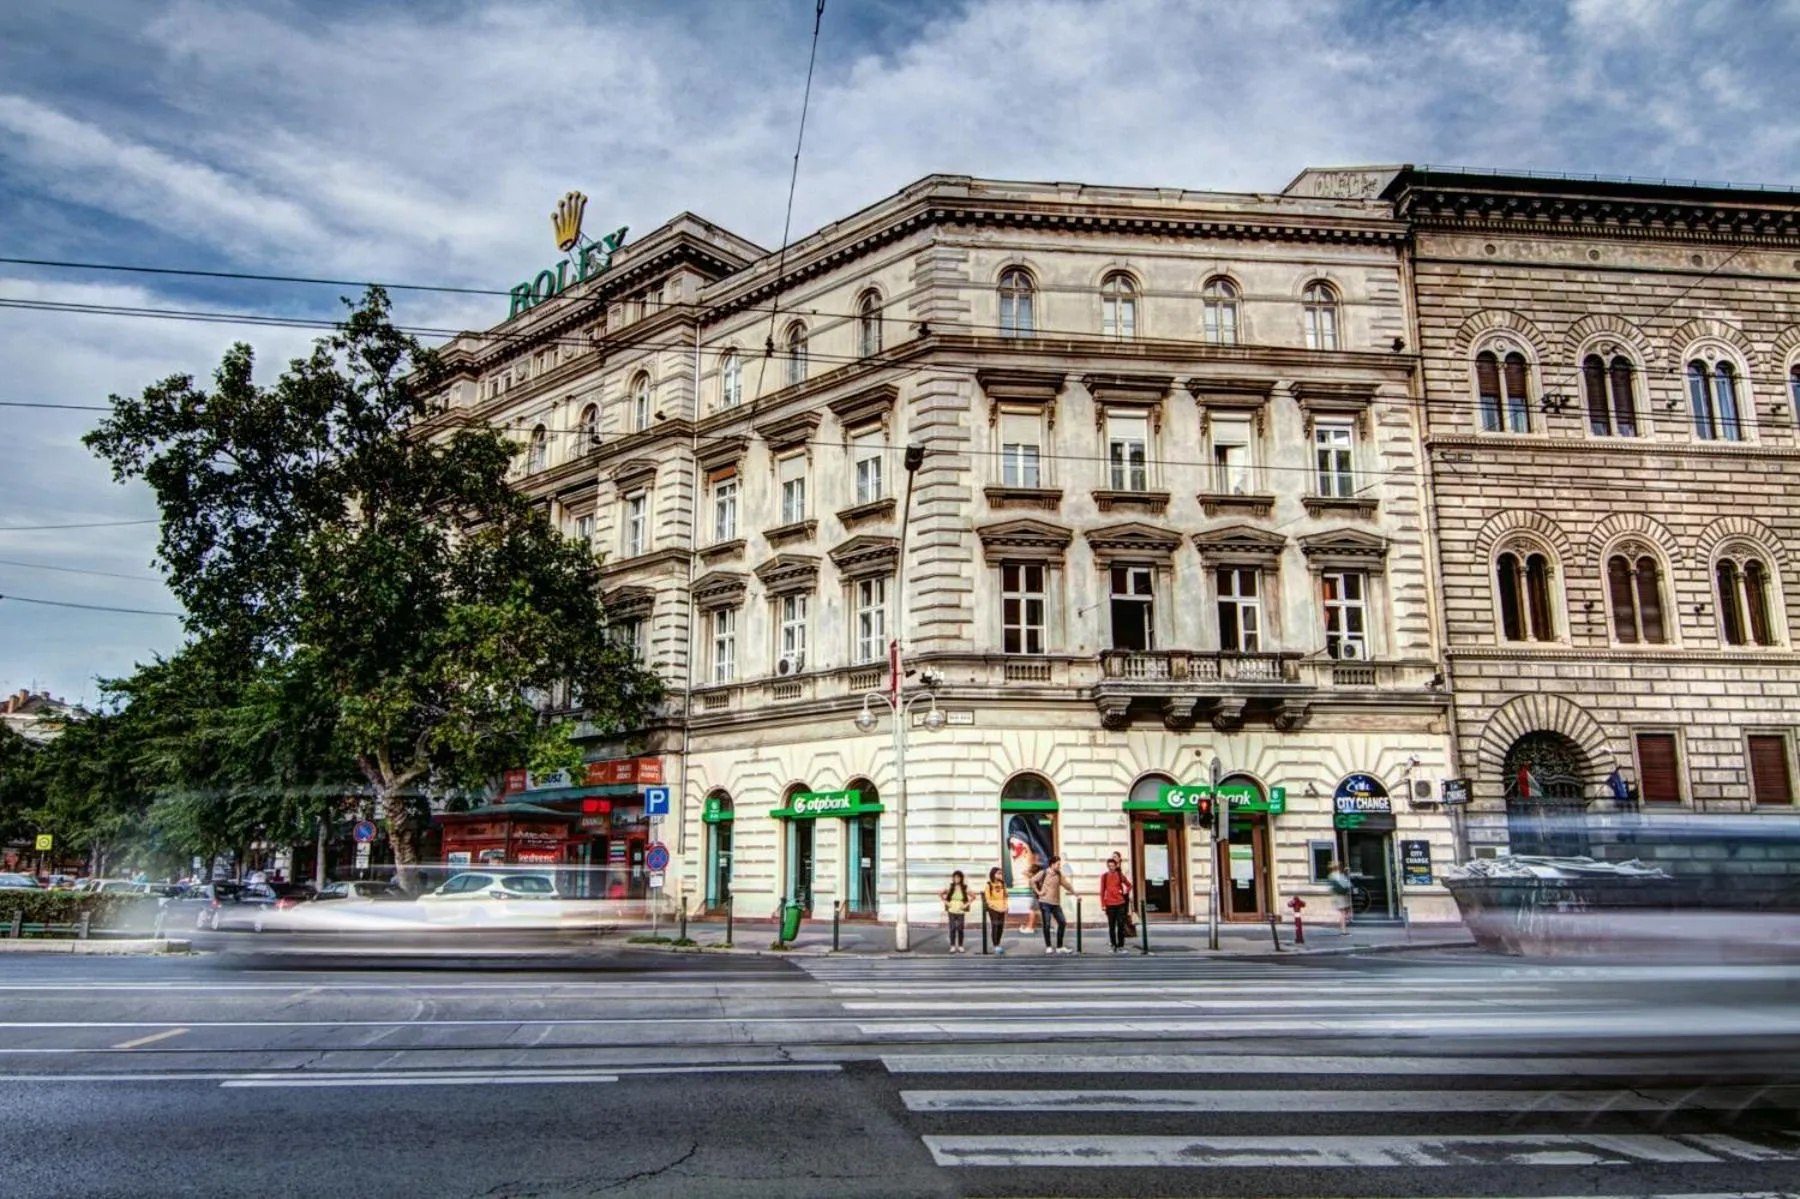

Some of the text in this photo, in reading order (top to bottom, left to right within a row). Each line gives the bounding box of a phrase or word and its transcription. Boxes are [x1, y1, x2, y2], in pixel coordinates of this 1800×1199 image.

[649, 790, 665, 812] P
[1337, 797, 1390, 809] CITY CHANGE
